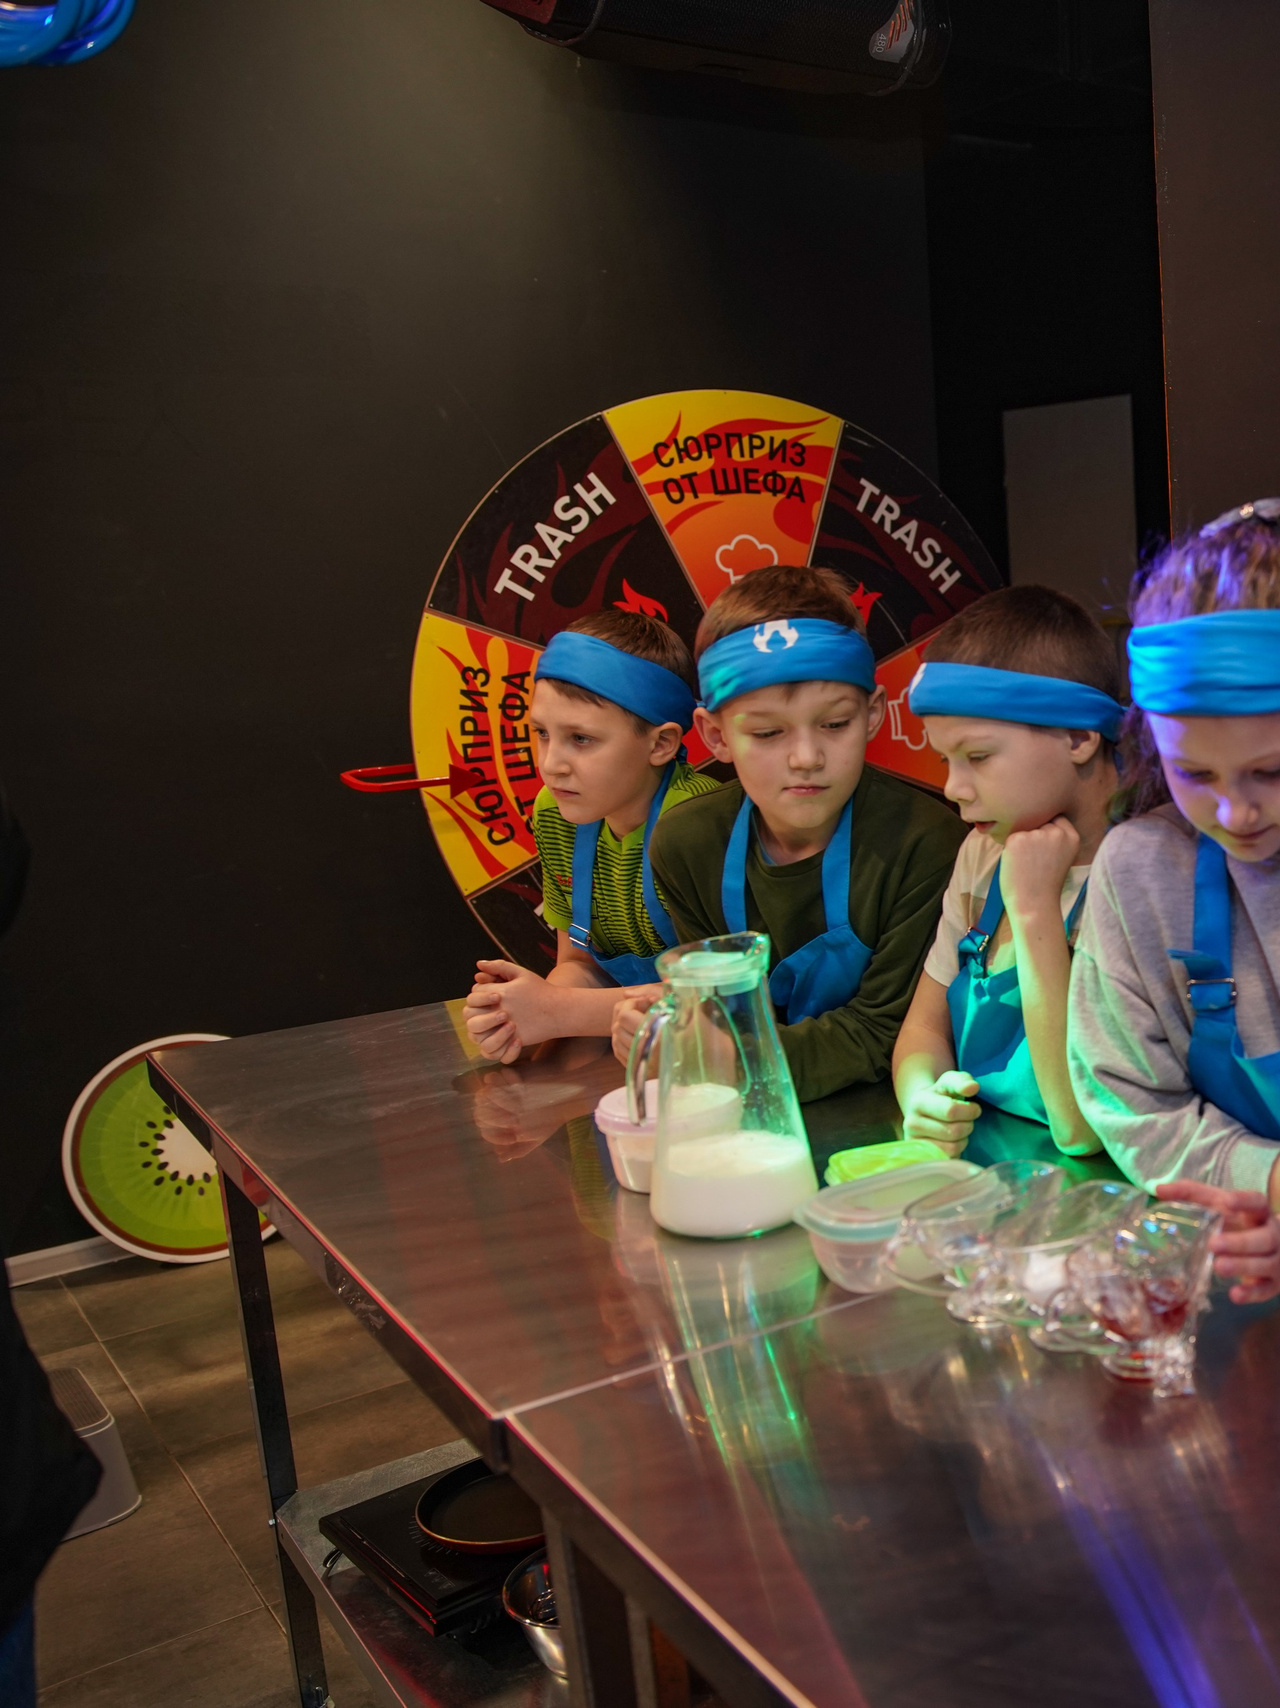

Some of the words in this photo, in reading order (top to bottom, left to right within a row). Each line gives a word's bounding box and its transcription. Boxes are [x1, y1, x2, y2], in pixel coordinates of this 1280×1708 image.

[875, 33, 887, 53] 480
[653, 432, 806, 468] СЮРПРИЗ
[662, 472, 699, 505] ОТ
[710, 467, 806, 503] ШЕФА
[493, 471, 617, 602] TRASH
[856, 477, 962, 595] TRASH
[498, 670, 537, 782] ШЕФА
